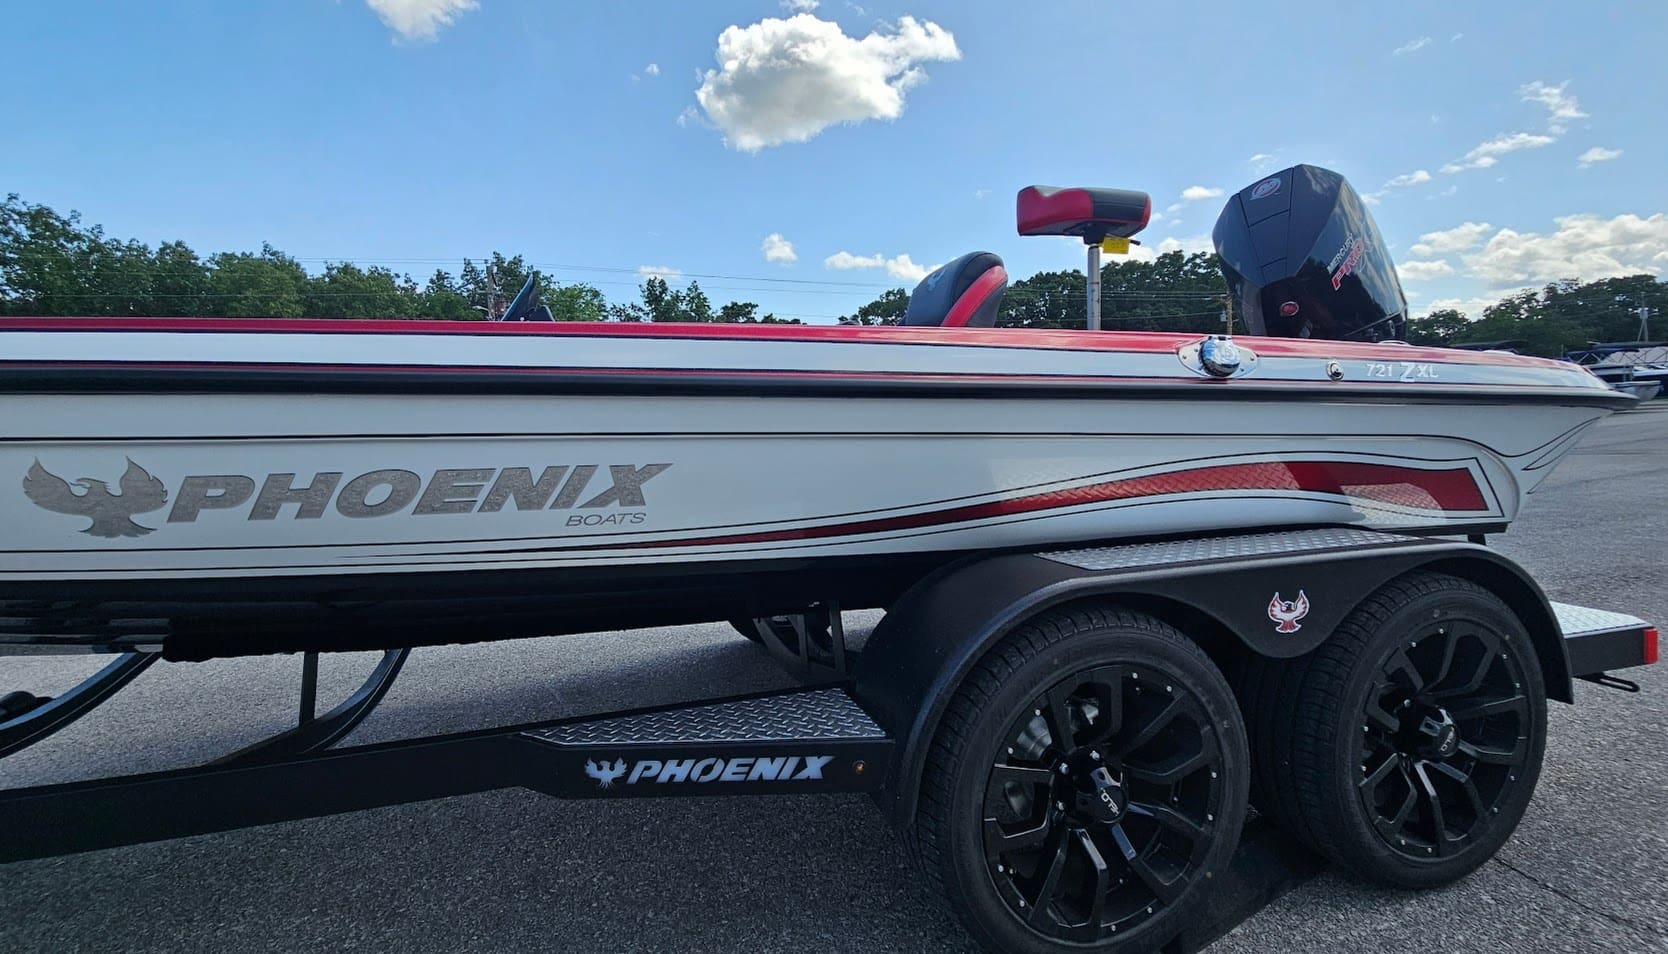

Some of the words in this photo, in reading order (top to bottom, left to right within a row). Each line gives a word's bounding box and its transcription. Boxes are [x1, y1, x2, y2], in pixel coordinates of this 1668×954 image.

[1327, 233, 1354, 274] MERCURY
[1366, 363, 1393, 377] 721
[166, 462, 673, 523] PHOENIX
[566, 512, 647, 527] BOATS
[626, 755, 835, 785] PHOENIX
